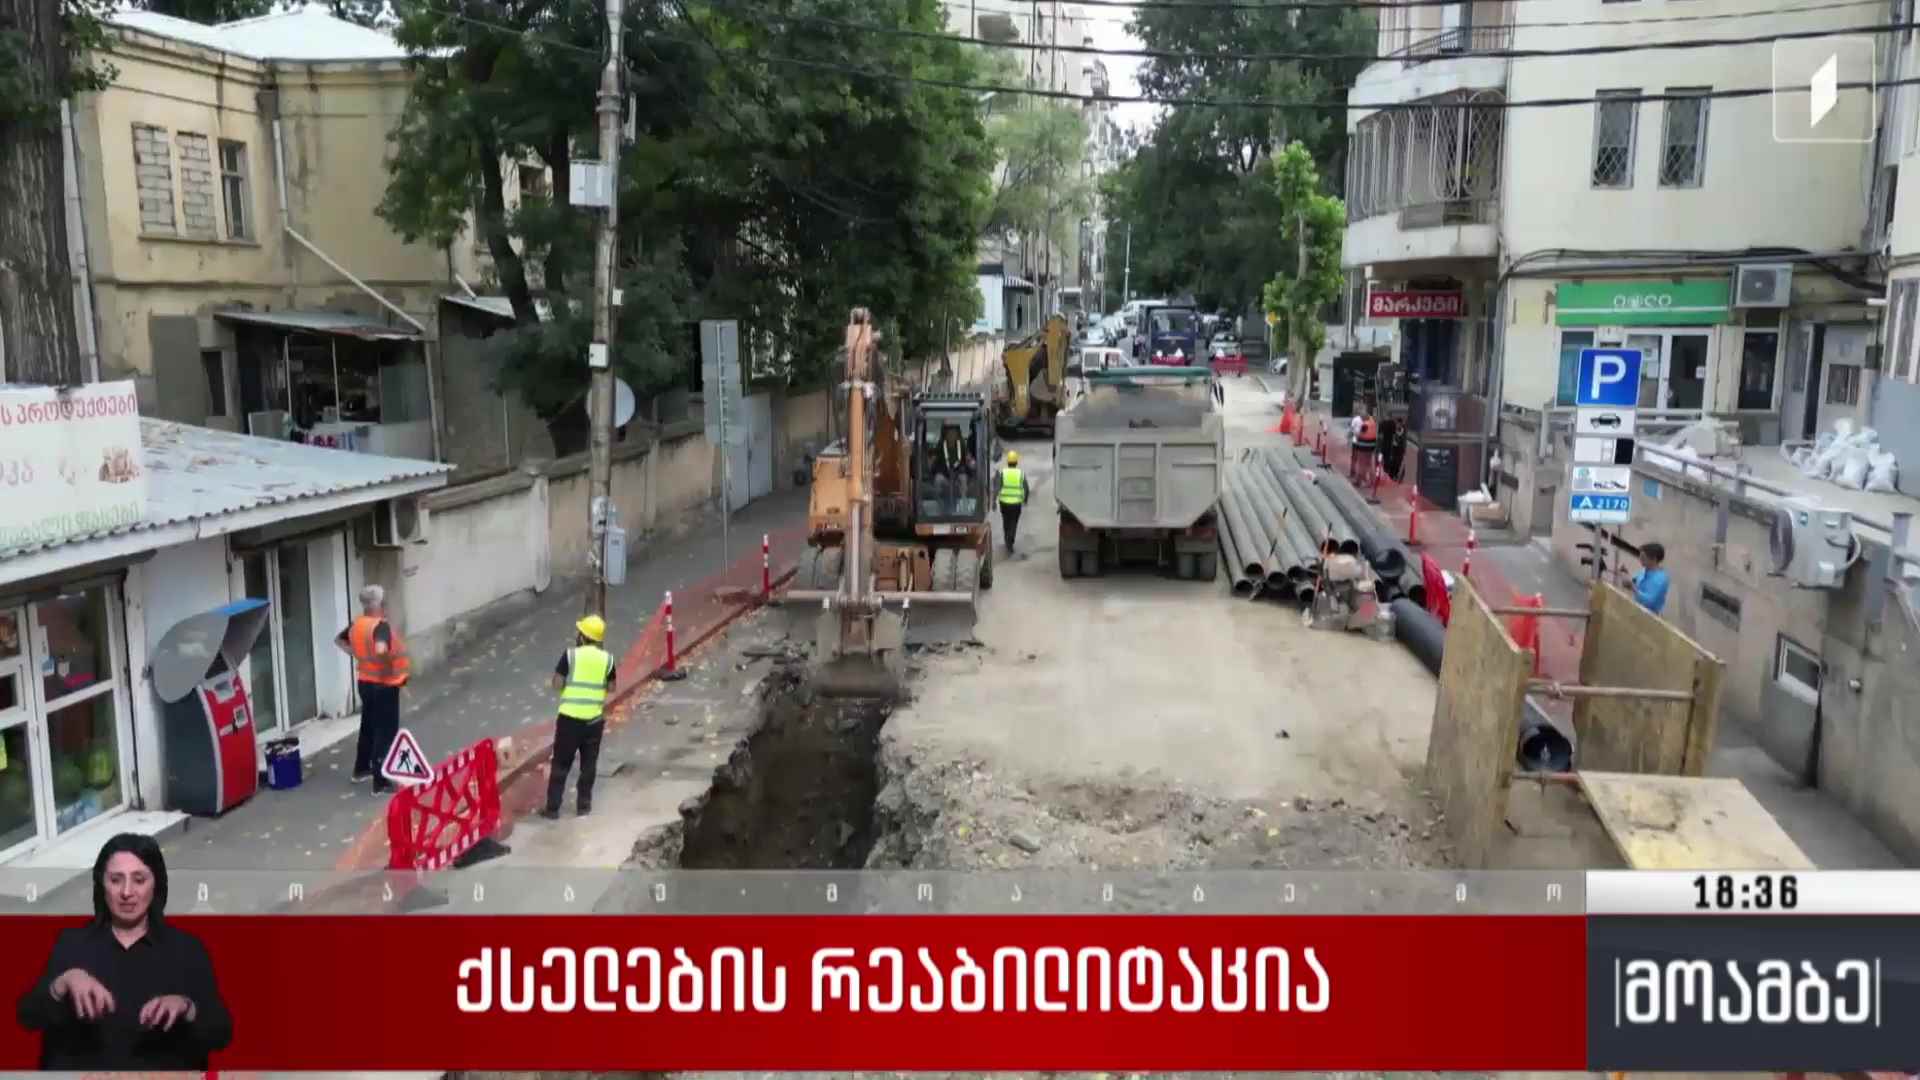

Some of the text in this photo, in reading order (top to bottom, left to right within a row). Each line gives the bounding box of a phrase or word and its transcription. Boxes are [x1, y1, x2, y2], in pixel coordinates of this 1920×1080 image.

[1372, 295, 1459, 313] მარკეტი
[1590, 355, 1627, 400] P
[17, 393, 136, 424] პროდუქტები
